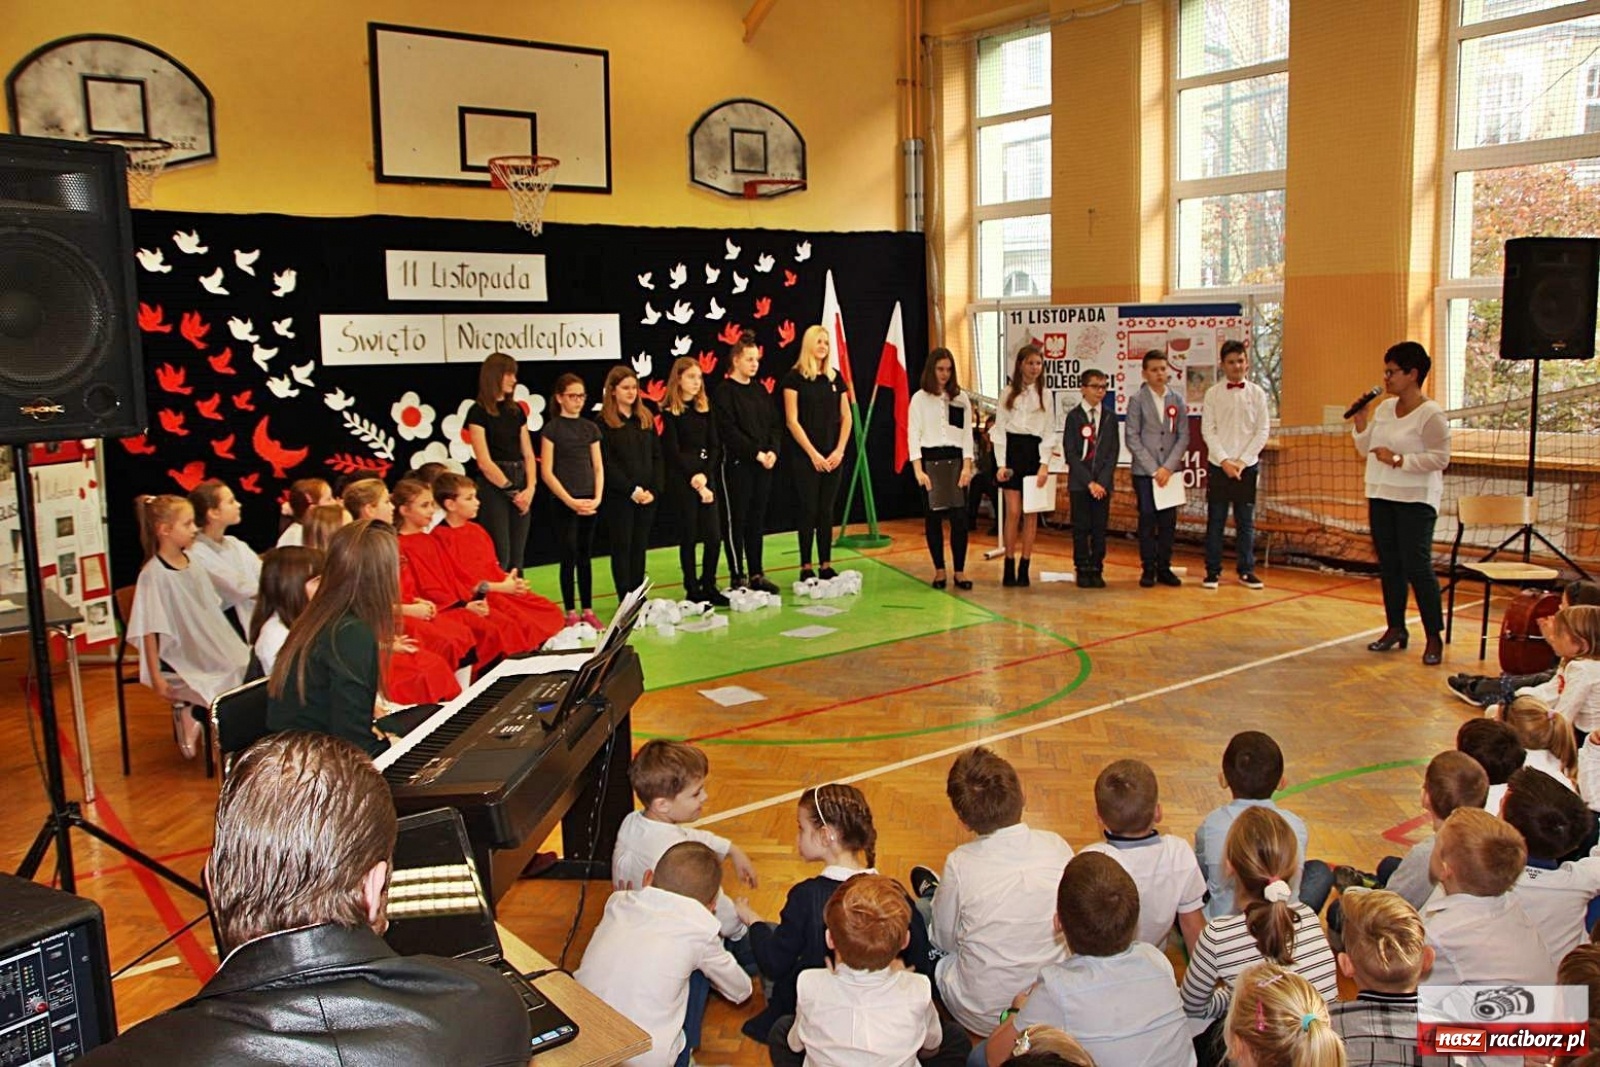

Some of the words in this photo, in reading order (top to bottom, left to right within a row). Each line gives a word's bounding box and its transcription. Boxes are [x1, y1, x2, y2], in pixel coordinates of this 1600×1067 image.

[398, 260, 417, 287] 11
[431, 261, 531, 298] Listopada
[1010, 310, 1023, 325] 11
[1028, 307, 1106, 324] LISTOPADA
[337, 320, 427, 357] Święto
[457, 321, 604, 356] Niepodległości
[1181, 450, 1201, 469] 11
